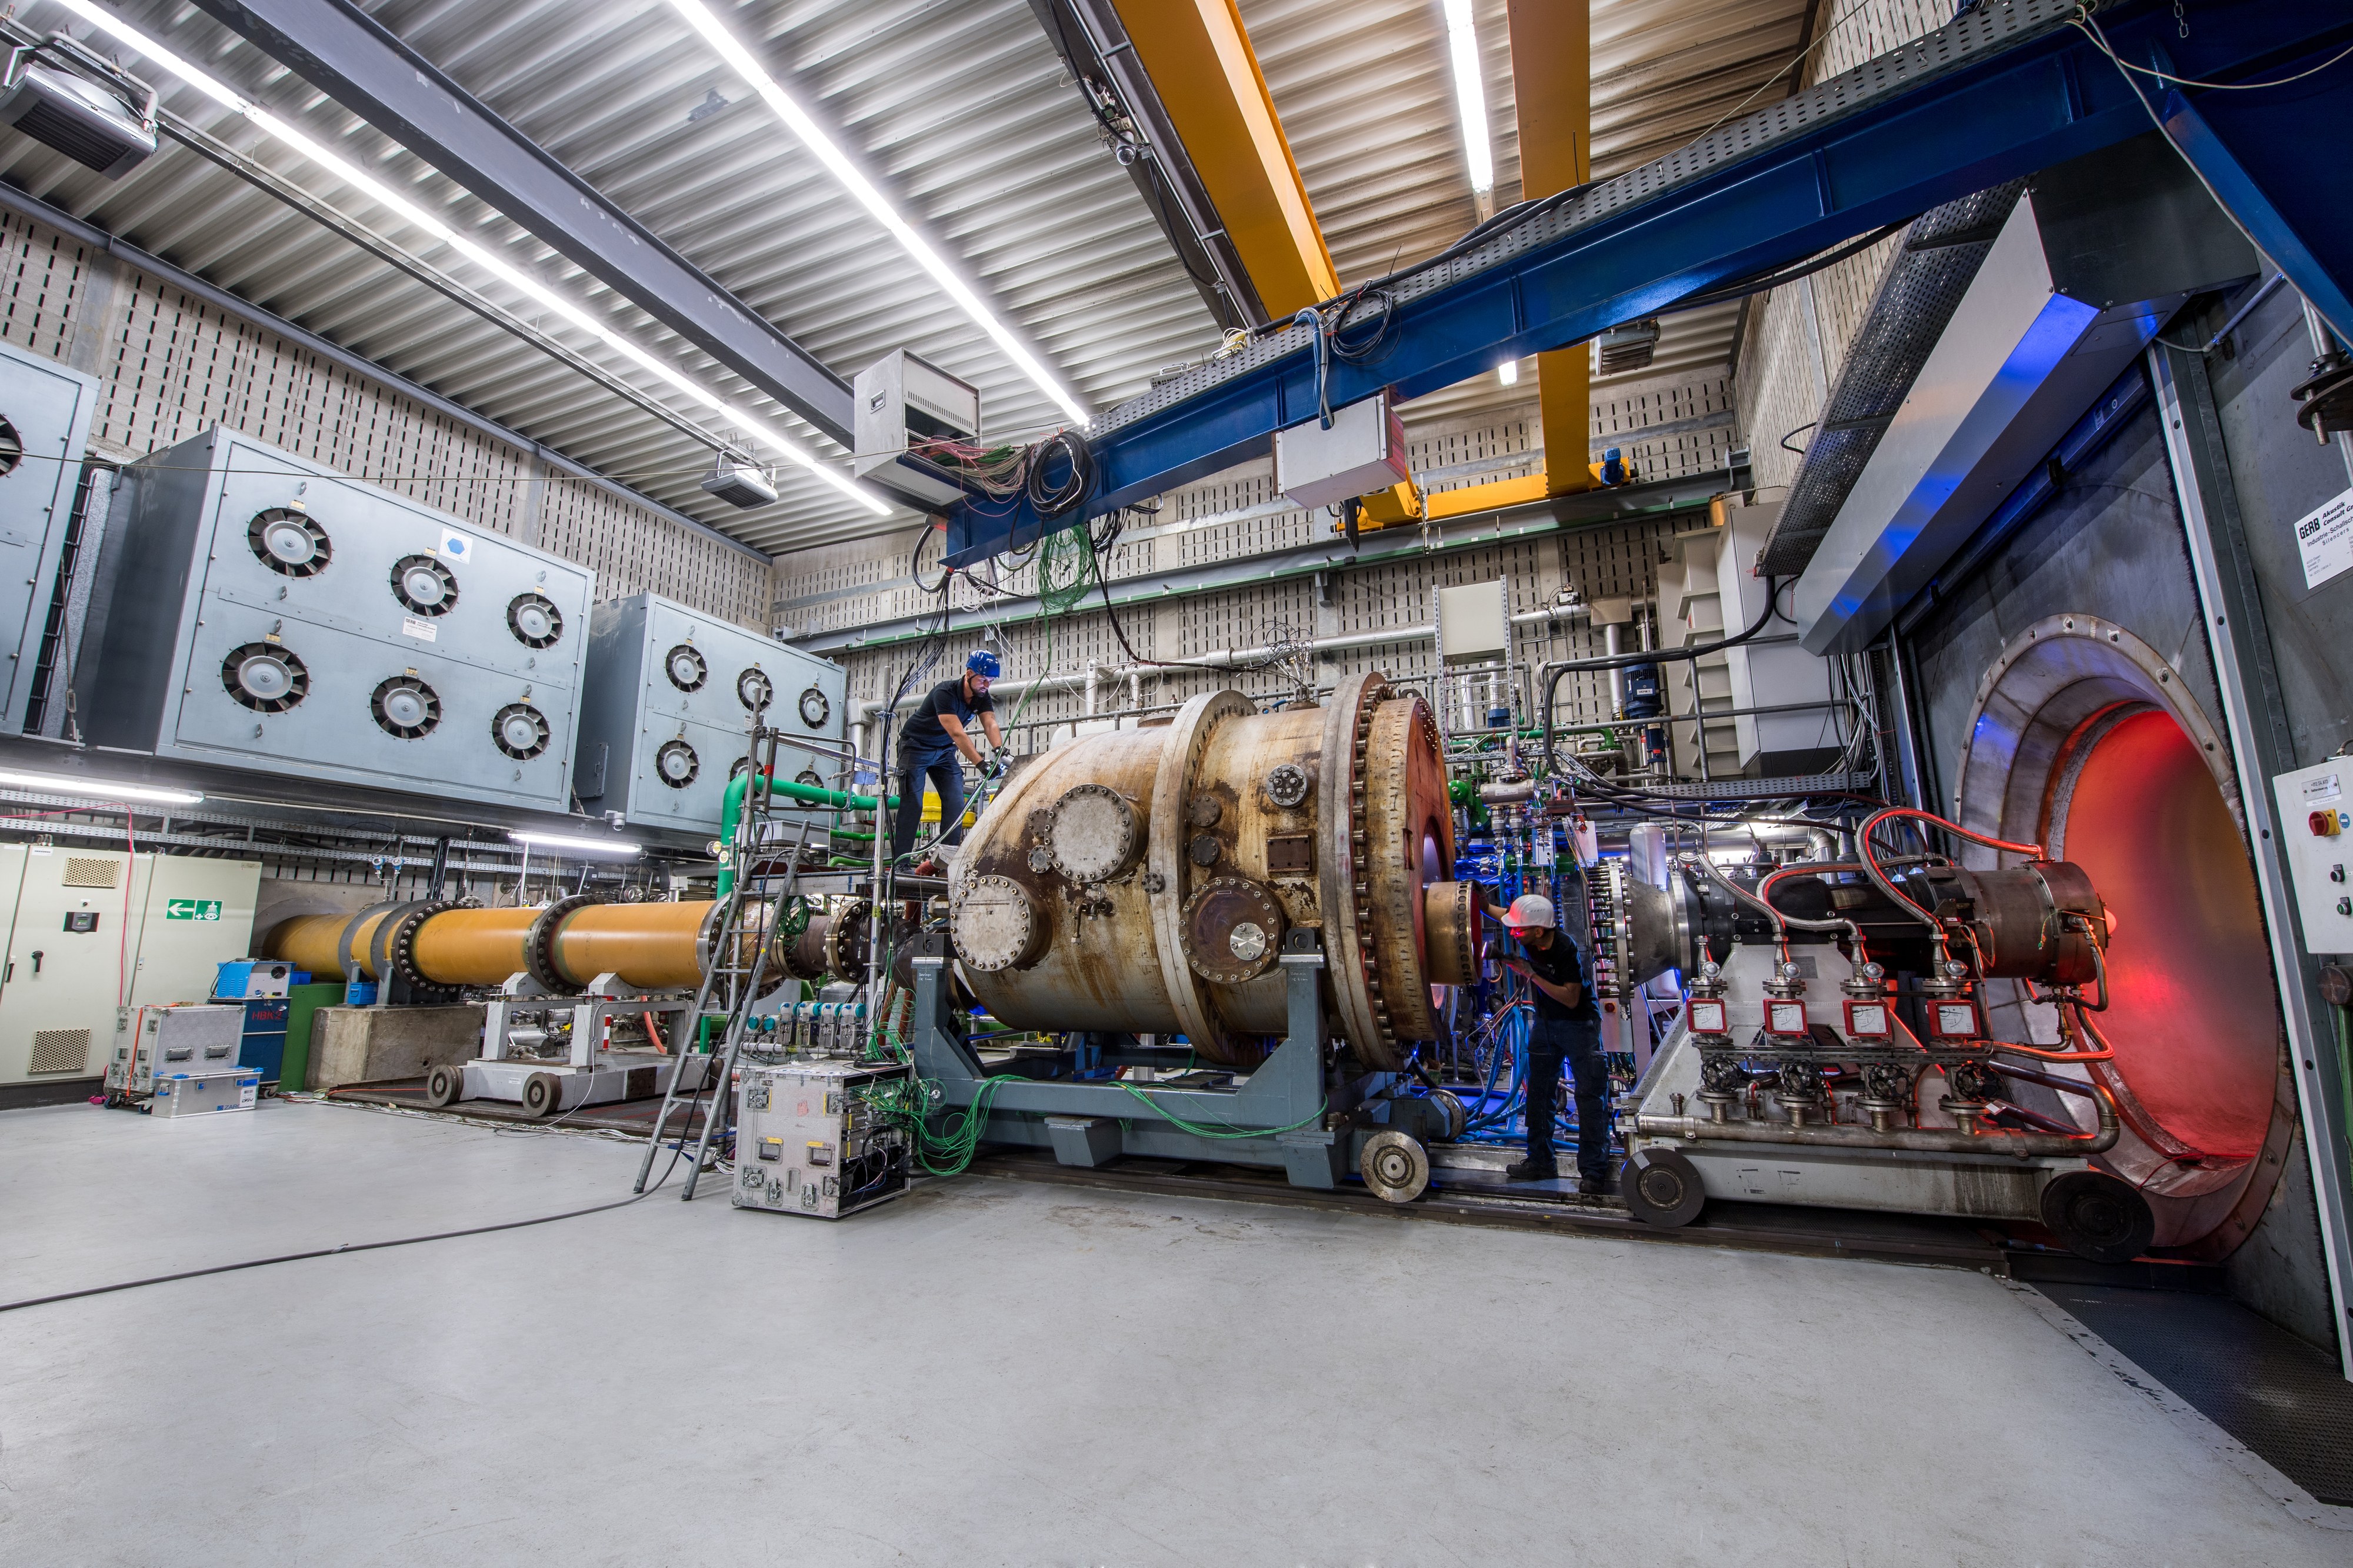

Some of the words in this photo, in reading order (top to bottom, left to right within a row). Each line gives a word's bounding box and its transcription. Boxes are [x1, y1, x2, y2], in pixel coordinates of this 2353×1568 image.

[2322, 502, 2345, 519] Akustik
[2324, 509, 2345, 526] Consult
[2299, 518, 2320, 539] GERB
[2322, 528, 2349, 546] Silencers
